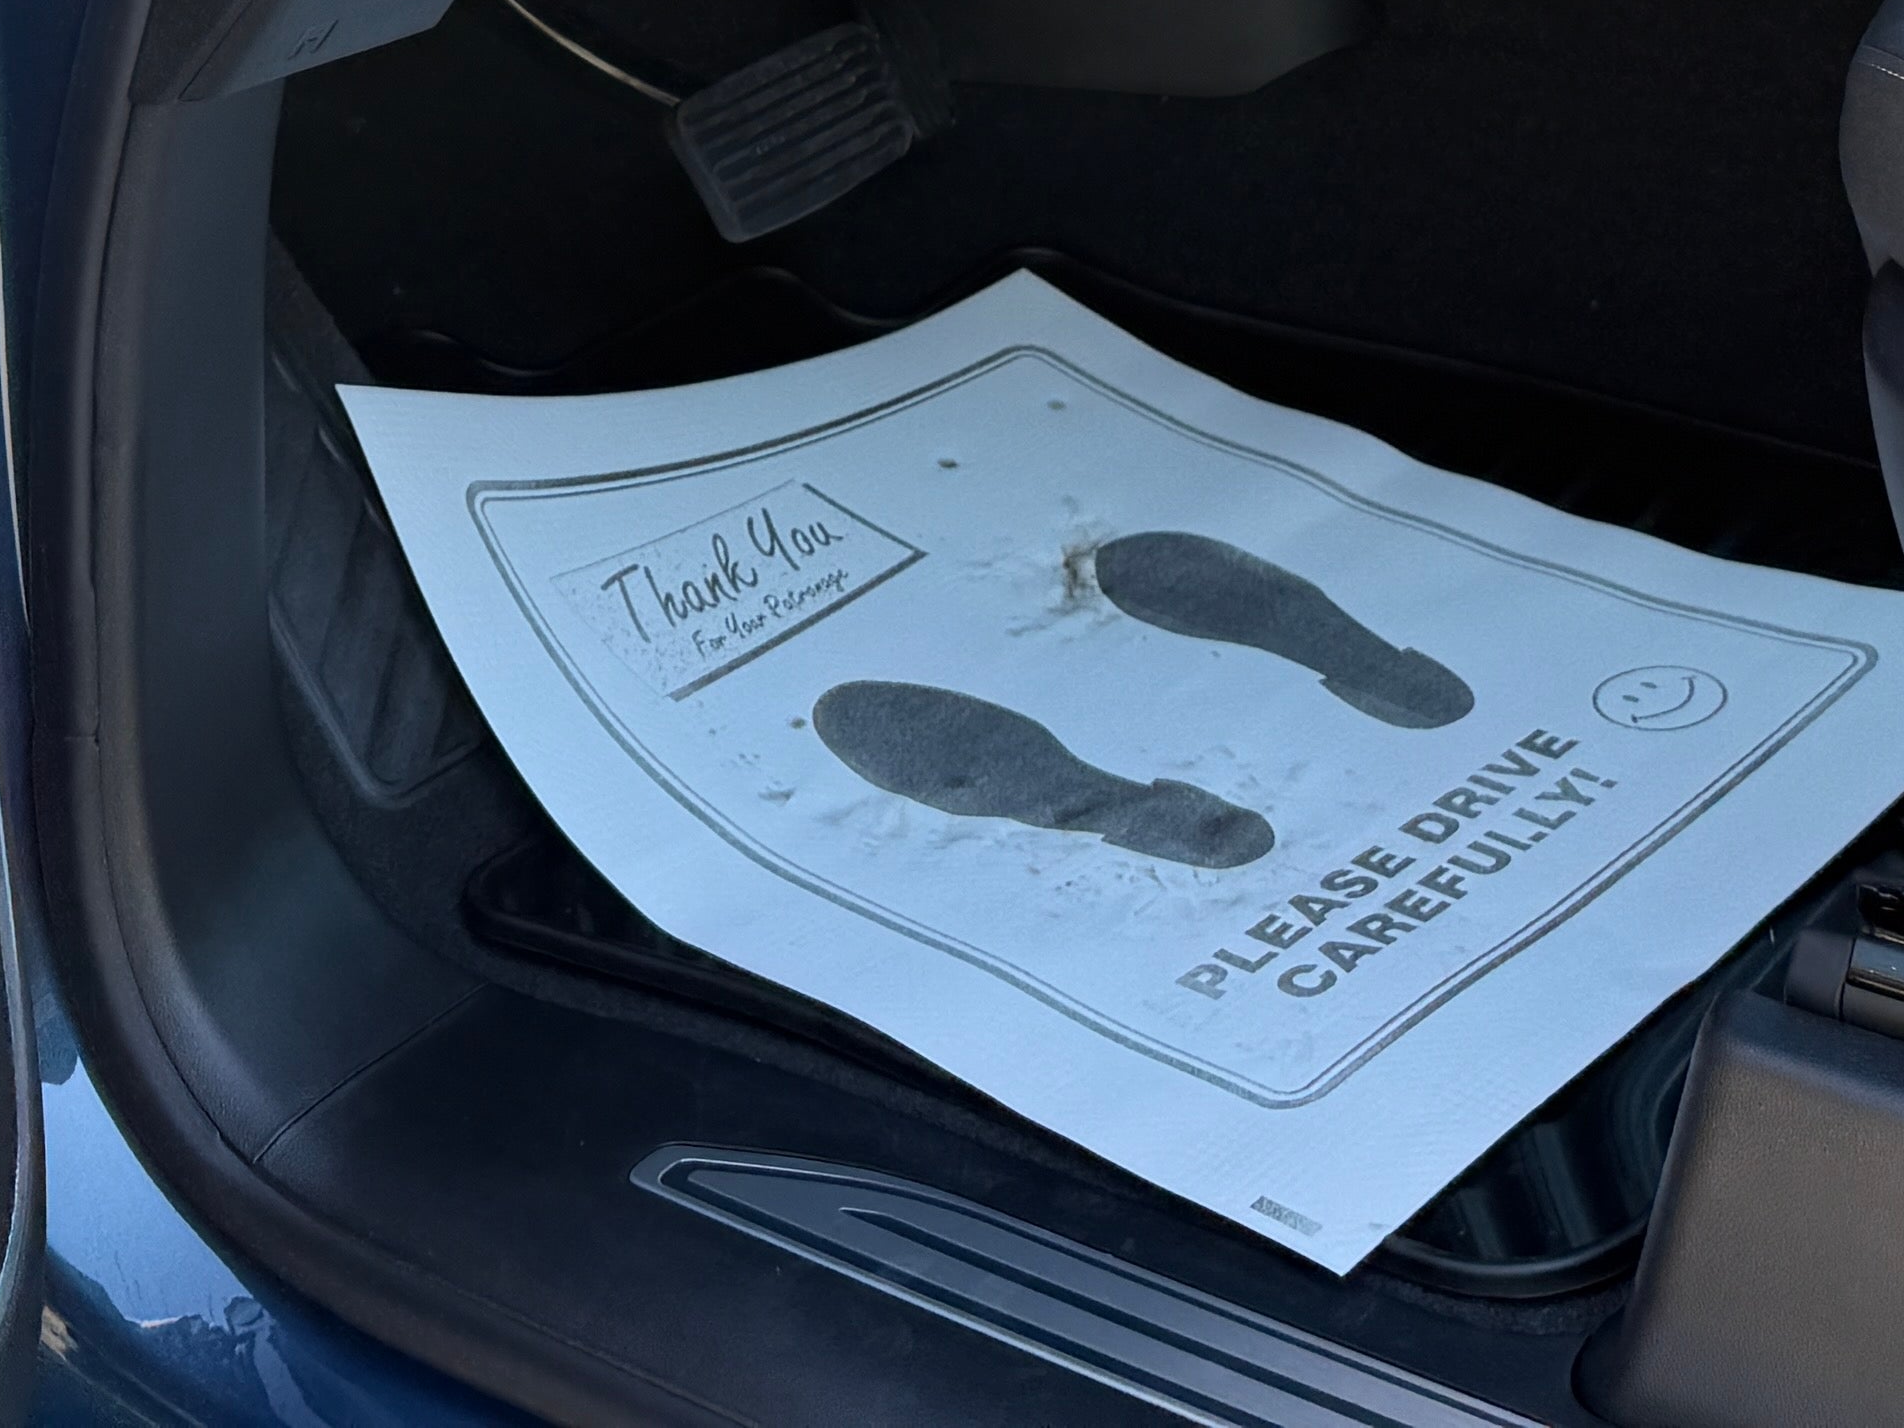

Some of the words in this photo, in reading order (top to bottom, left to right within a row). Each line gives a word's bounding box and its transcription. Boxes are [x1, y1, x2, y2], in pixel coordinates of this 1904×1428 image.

[600, 532, 759, 645] Thank
[746, 507, 844, 572] You
[692, 630, 728, 658] For
[725, 612, 768, 640] Your
[763, 568, 850, 620] Patronage
[1175, 845, 1417, 1001] PLEASE
[1398, 727, 1582, 845] DRIVE
[1276, 766, 1620, 999] CAREFULLY!
